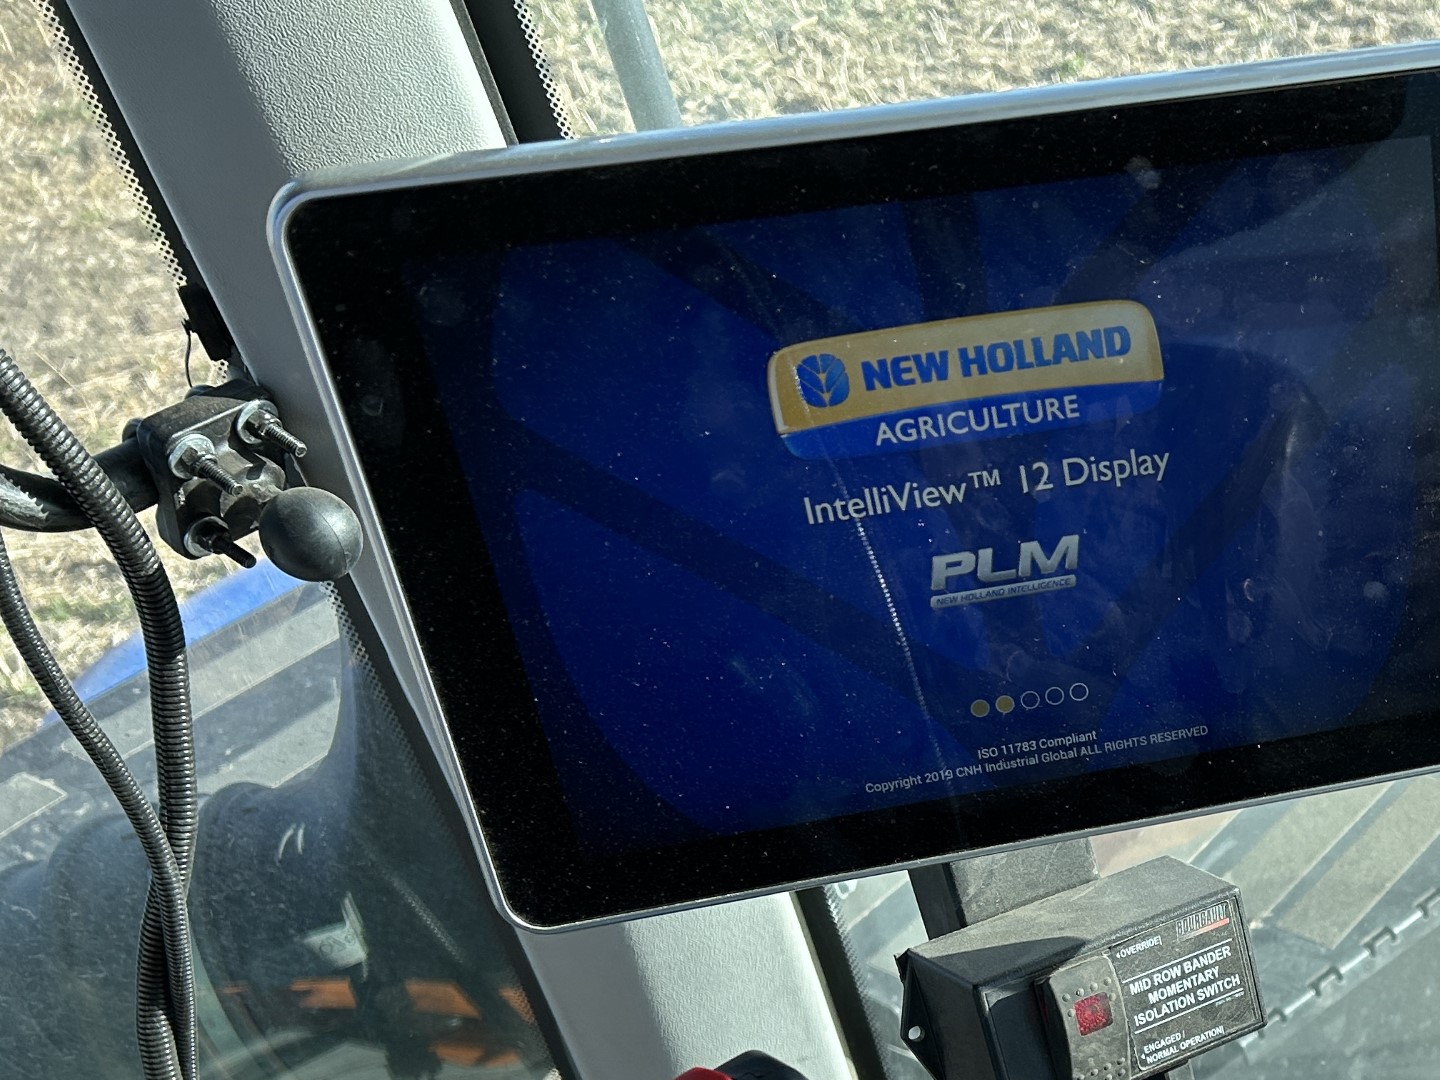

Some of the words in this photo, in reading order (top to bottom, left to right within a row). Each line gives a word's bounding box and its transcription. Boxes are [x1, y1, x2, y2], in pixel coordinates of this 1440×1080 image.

[860, 349, 949, 392] NEW
[959, 326, 1131, 377] HOLLAND
[876, 395, 1080, 446] AGRICULTURE
[1018, 462, 1054, 493] 12
[1063, 448, 1170, 488] Display
[931, 534, 1079, 591] PLM
[936, 596, 958, 606] NEW
[960, 588, 1005, 602] HOLLAND
[1008, 577, 1073, 594] INTELLIGENCE
[865, 775, 922, 794] Copyright
[924, 769, 953, 783] 2019
[956, 764, 983, 778] CNH
[985, 754, 1039, 773] Industrial
[1041, 747, 1078, 763] Global
[1080, 744, 1102, 757] ALL
[1104, 736, 1148, 753] RIGHTS
[1150, 725, 1208, 745] RESERVED
[977, 747, 998, 760] ISO
[1000, 740, 1037, 756] 11783
[1039, 730, 1097, 748] Compliant
[1129, 978, 1152, 995] MID
[1153, 967, 1183, 986] ROW
[1184, 946, 1232, 974] BANDER
[1148, 966, 1220, 1004] MOMENTARY
[1134, 994, 1197, 1027] ISOLATION
[1197, 974, 1241, 1001] SWITCH
[1143, 1031, 1182, 1054] ENGAGED
[1146, 1045, 1179, 1065] NORMAL
